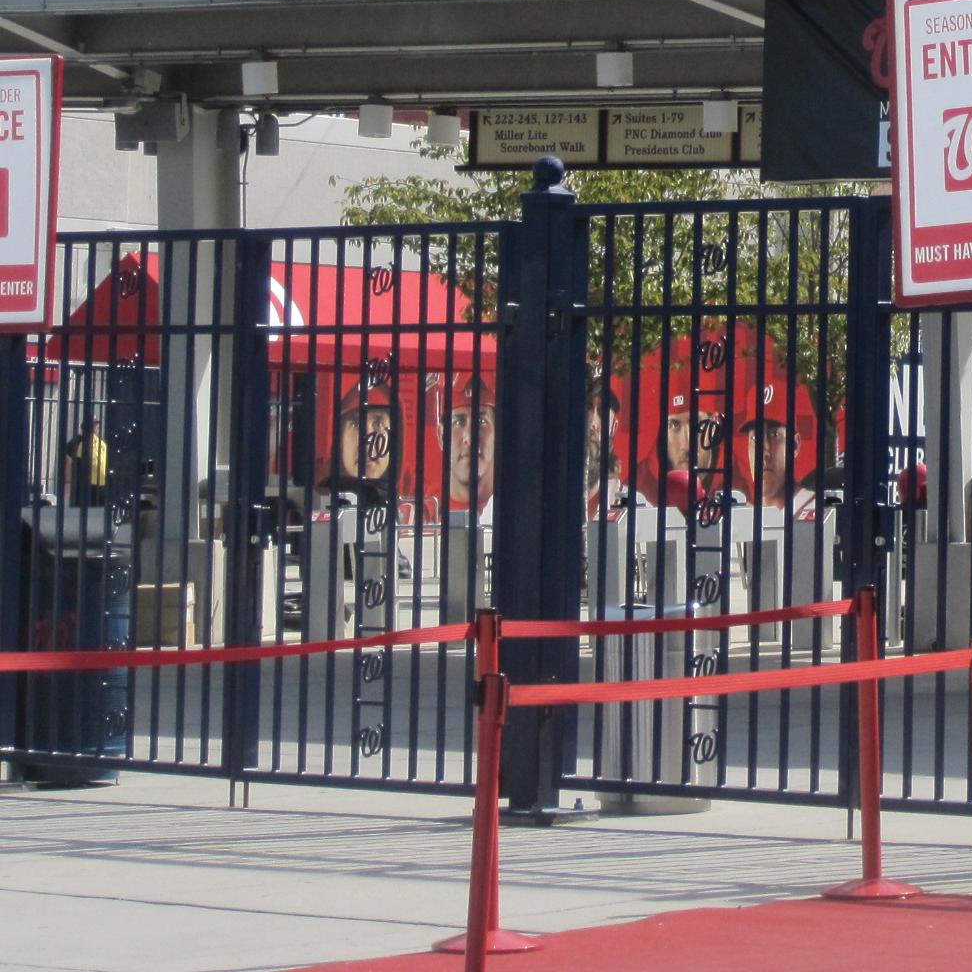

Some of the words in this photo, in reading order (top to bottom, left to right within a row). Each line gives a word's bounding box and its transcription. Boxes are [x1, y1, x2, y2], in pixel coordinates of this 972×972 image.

[494, 114, 541, 125] 222-245,
[545, 113, 587, 124] 127-143
[625, 111, 657, 123] Suites
[661, 112, 684, 123] 1-79
[494, 130, 524, 140] Miller
[528, 130, 548, 140] Lite
[625, 129, 647, 139] PNC
[651, 128, 696, 139] Diamond
[500, 143, 556, 153] Scoreboard
[560, 142, 585, 152] Walk
[624, 145, 679, 156] Presidents
[682, 144, 705, 155] Club
[914, 245, 949, 264] MUST
